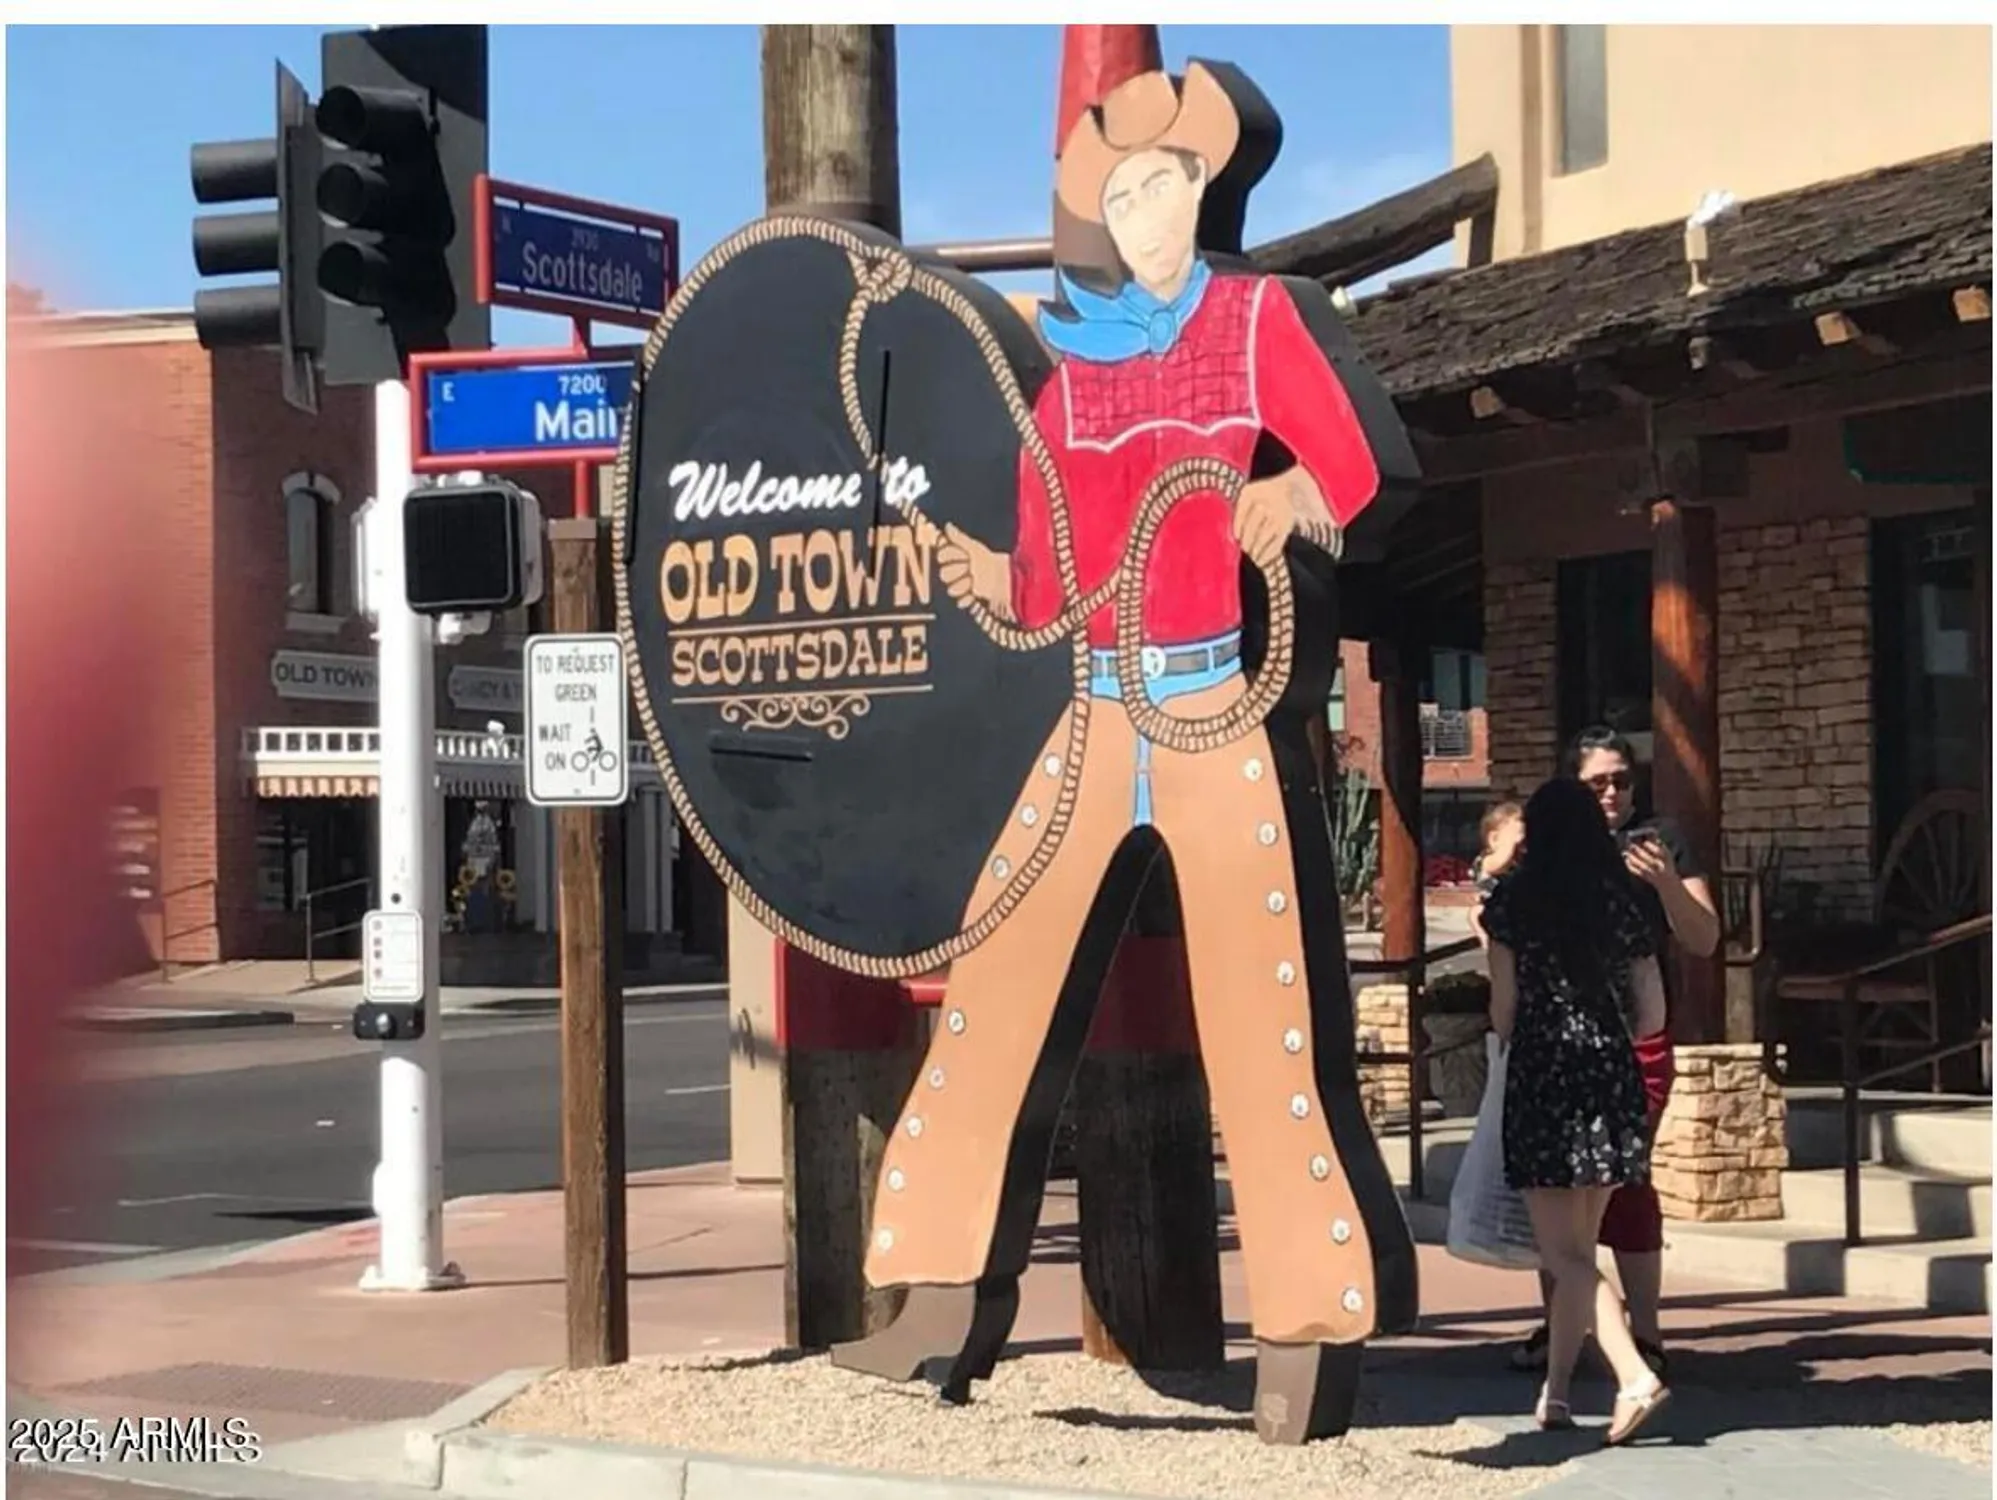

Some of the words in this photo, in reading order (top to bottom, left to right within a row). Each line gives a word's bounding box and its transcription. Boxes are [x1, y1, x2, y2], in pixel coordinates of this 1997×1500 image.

[522, 241, 643, 303] Scottsdale
[442, 382, 455, 401] E
[668, 460, 862, 522] Welcome
[884, 456, 931, 507] to
[661, 534, 760, 624] OLD
[770, 524, 938, 614] TOWN
[536, 656, 552, 673] TO
[557, 655, 615, 673] REQUEST
[671, 624, 929, 688] SCOTTSDALE
[275, 662, 318, 684] OLD
[555, 683, 597, 701] GREEN
[538, 724, 571, 742] WAIT
[545, 752, 566, 770] ON
